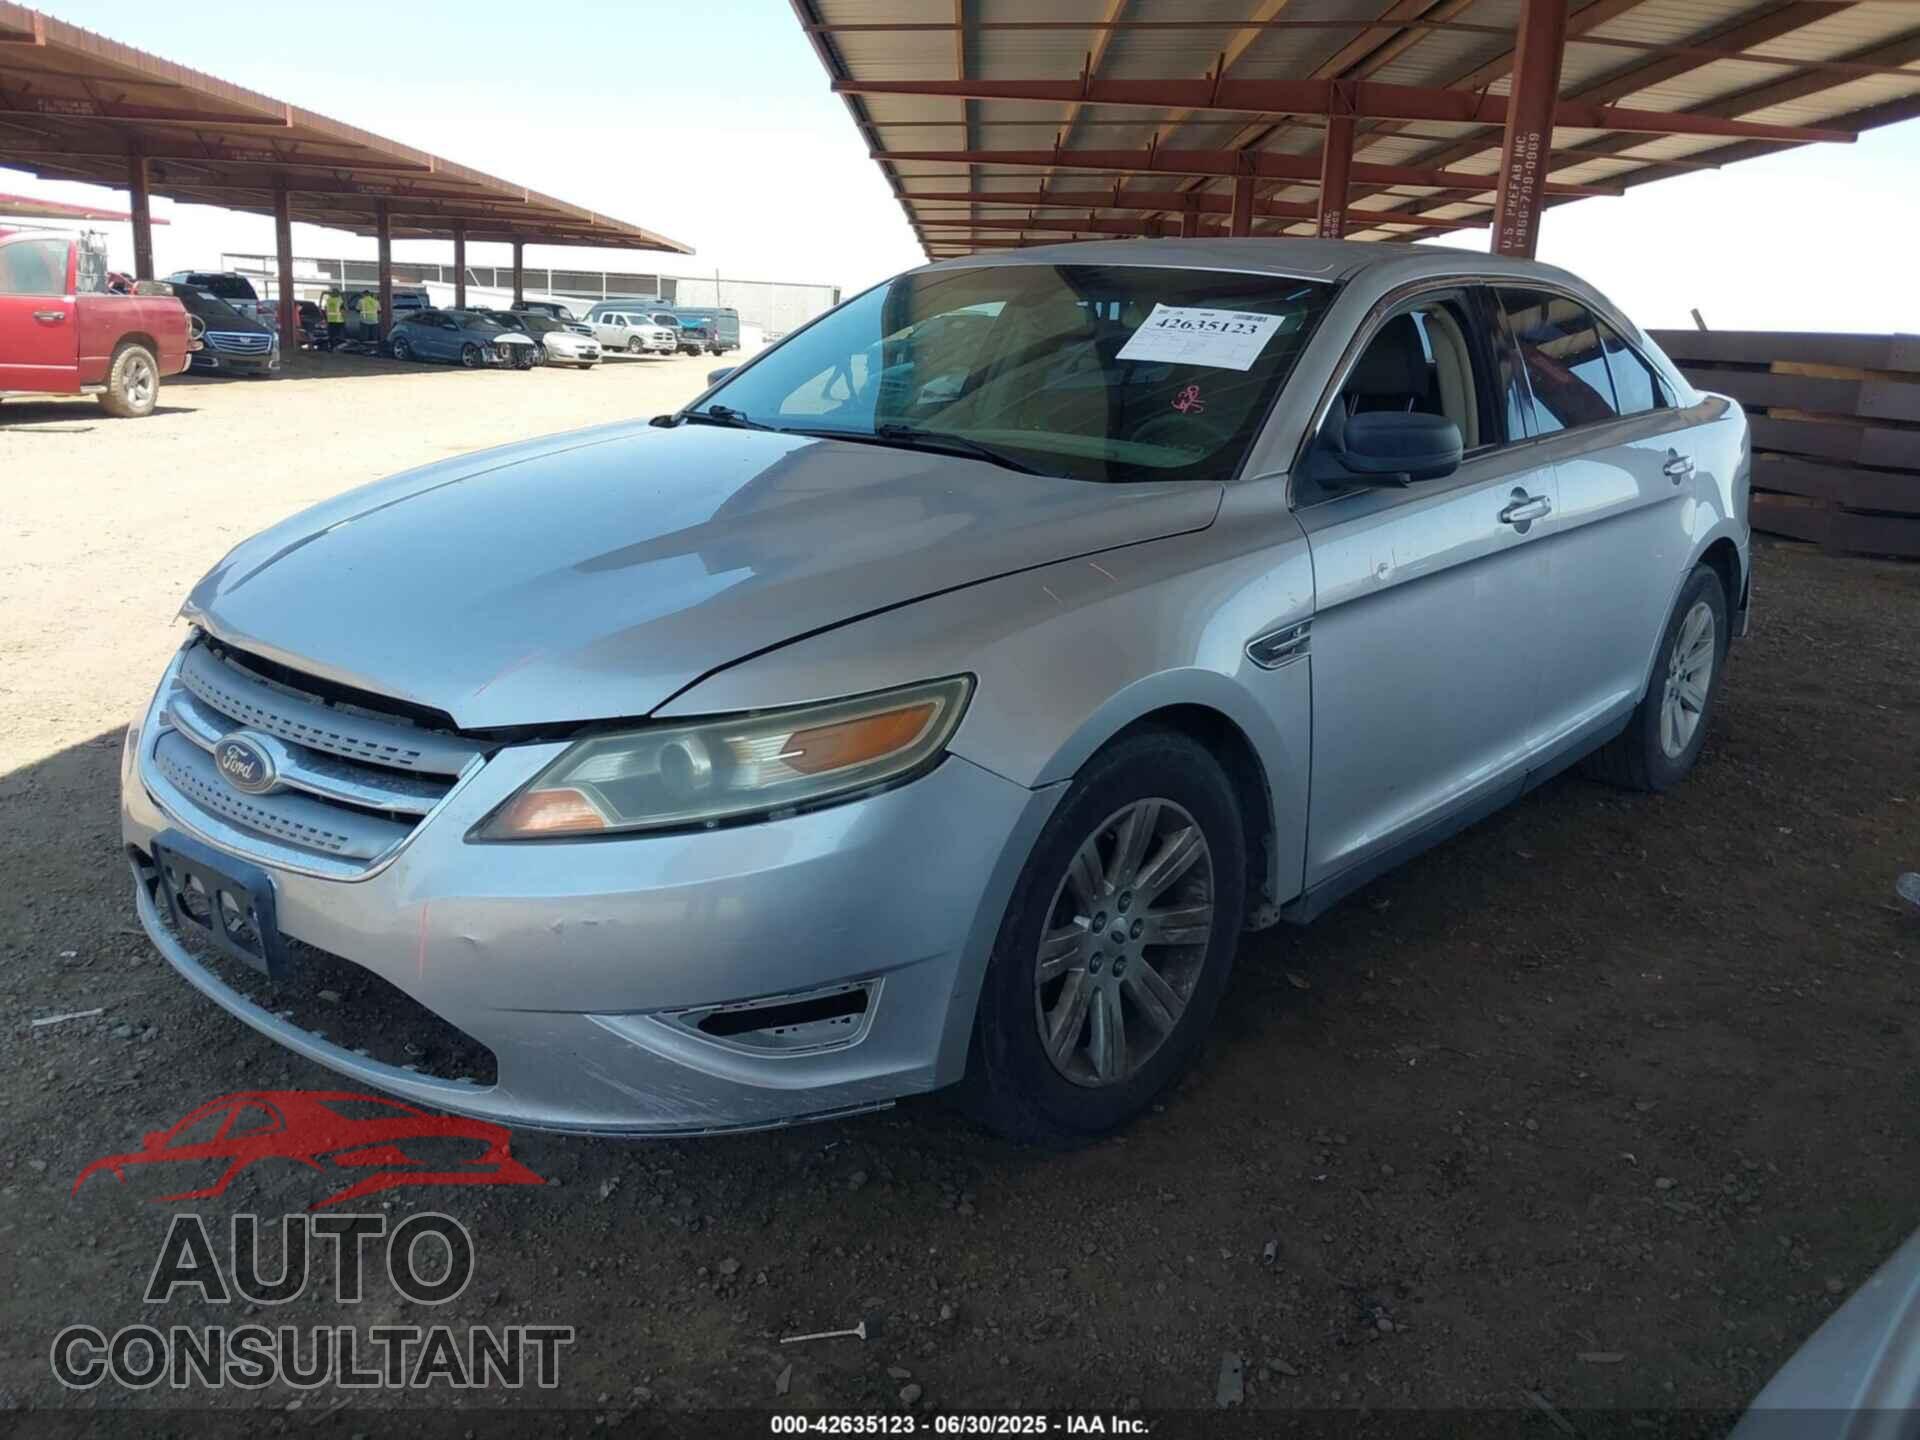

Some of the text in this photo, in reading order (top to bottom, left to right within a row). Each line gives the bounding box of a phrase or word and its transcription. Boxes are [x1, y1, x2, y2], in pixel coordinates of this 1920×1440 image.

[1506, 164, 1523, 216] PREFAB
[1155, 318, 1258, 335] 42635123
[223, 744, 255, 779] Ford
